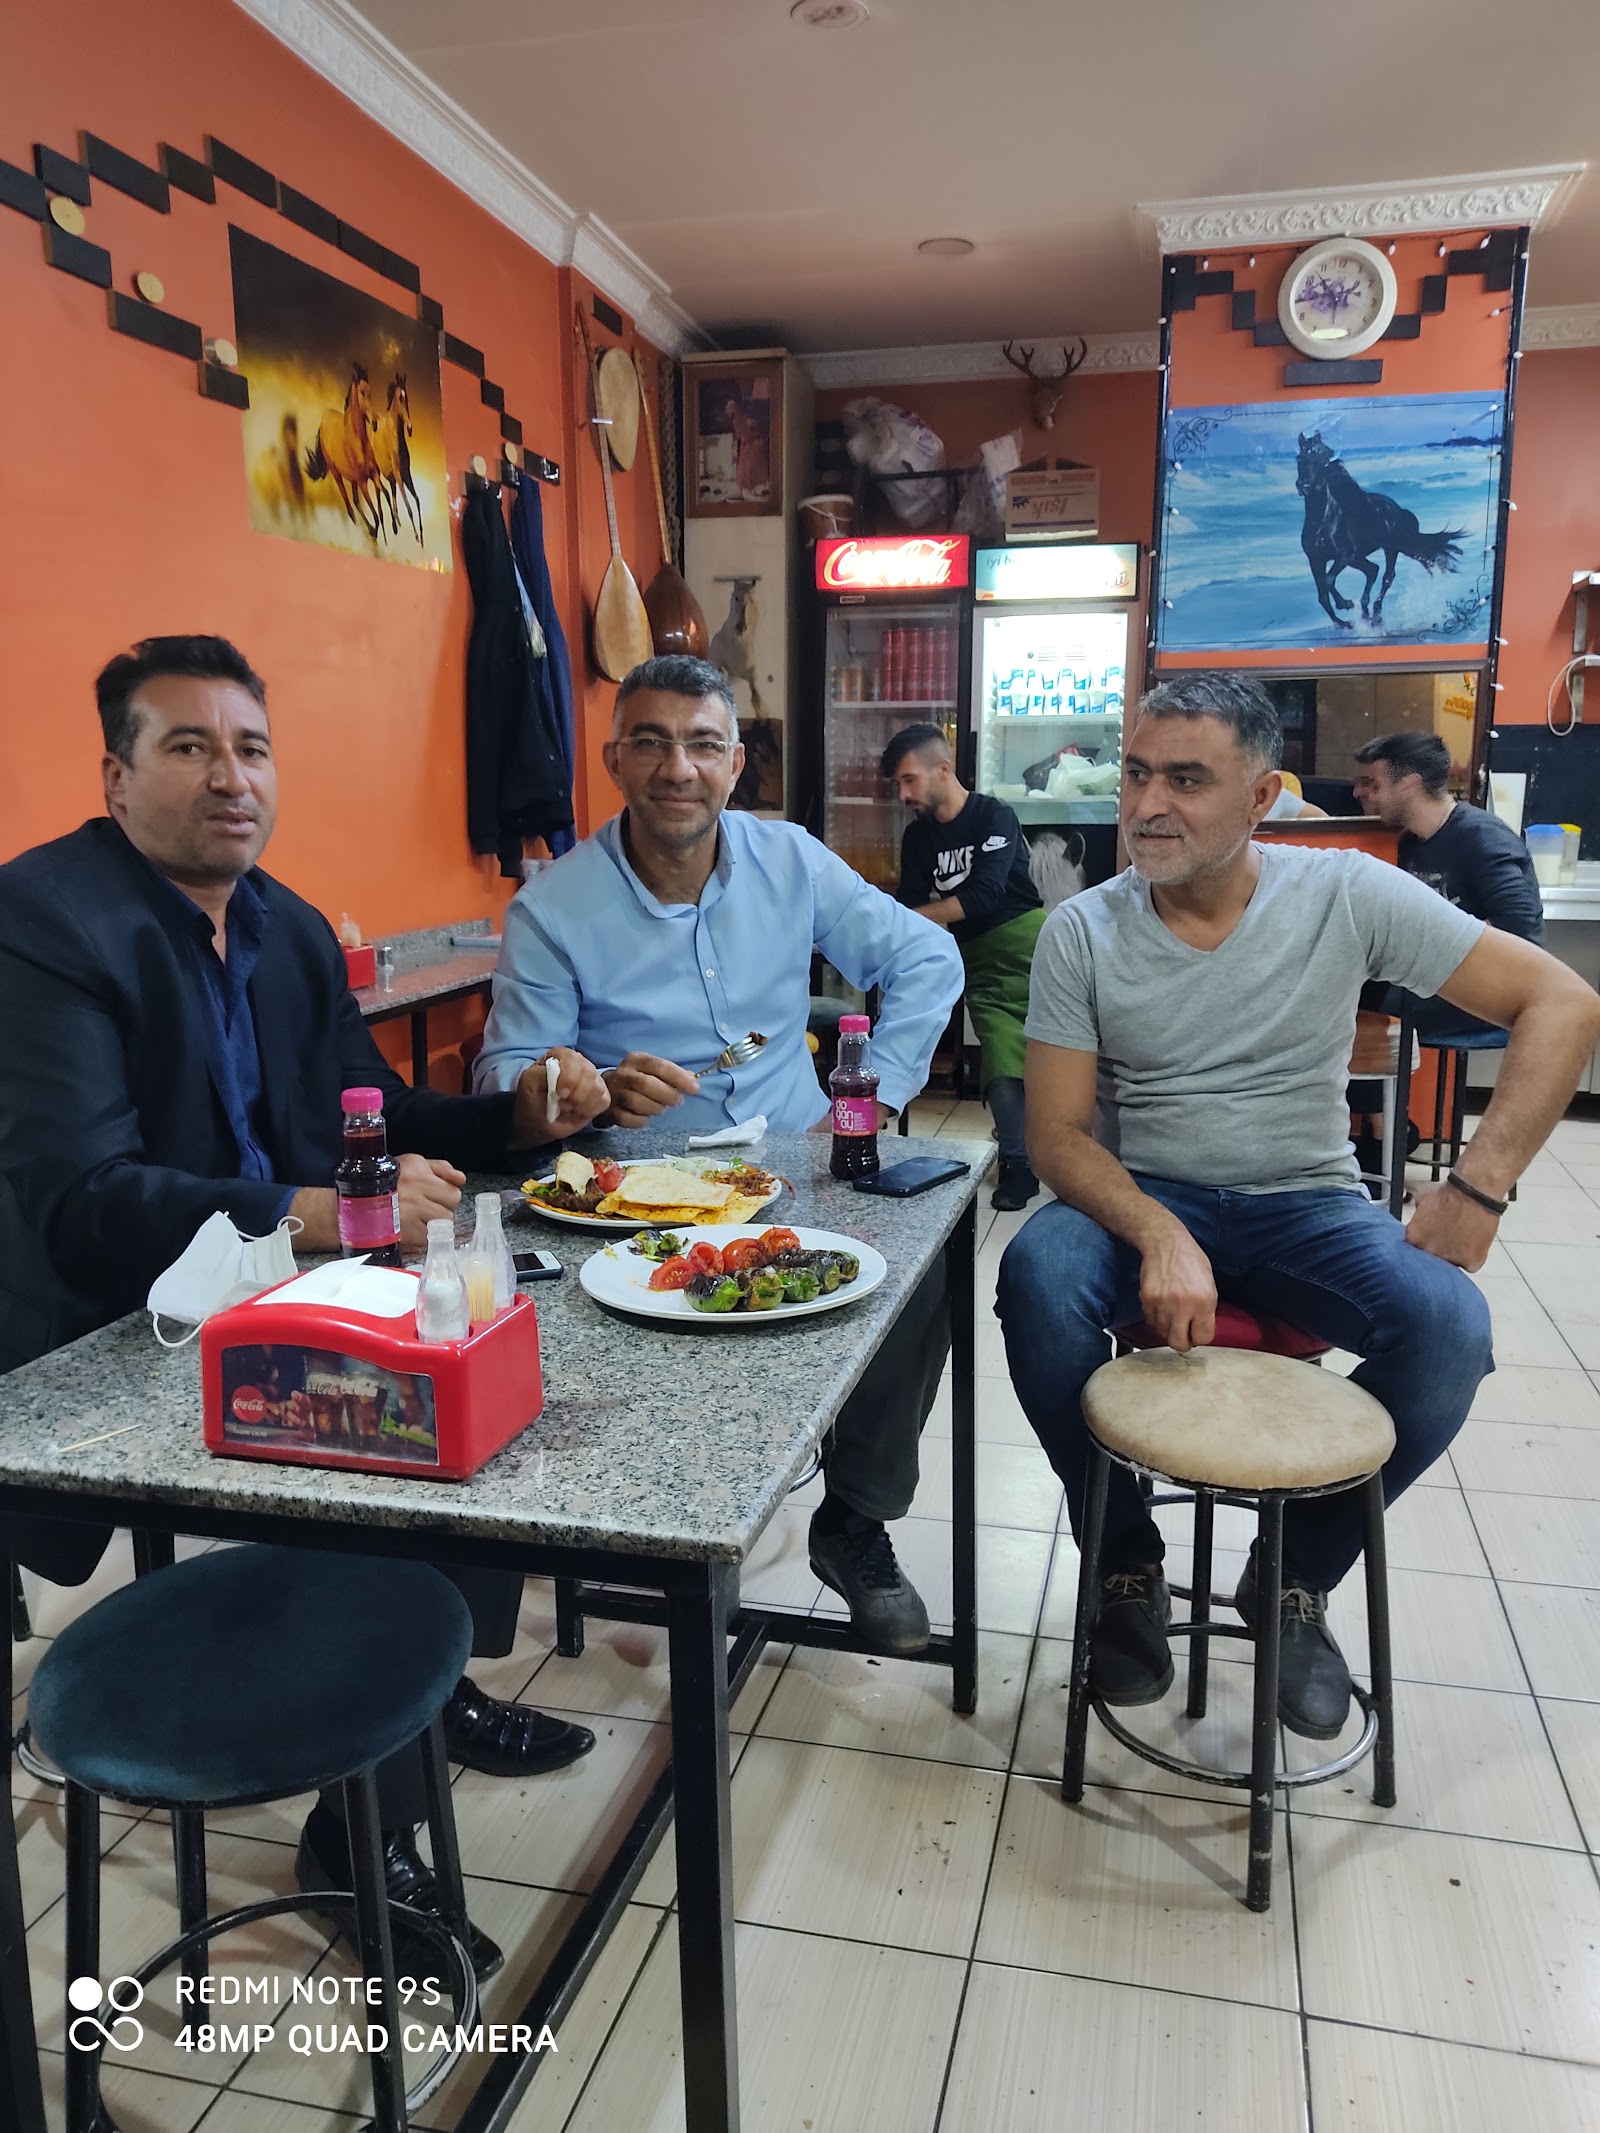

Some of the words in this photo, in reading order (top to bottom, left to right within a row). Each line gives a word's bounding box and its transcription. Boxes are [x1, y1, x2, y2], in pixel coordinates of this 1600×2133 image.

[1320, 264, 1327, 272] 11
[1339, 260, 1348, 268] 12
[1305, 276, 1314, 287] 10
[1368, 280, 1374, 288] 2
[1300, 312, 1305, 320] 8
[937, 845, 975, 876] NIKE
